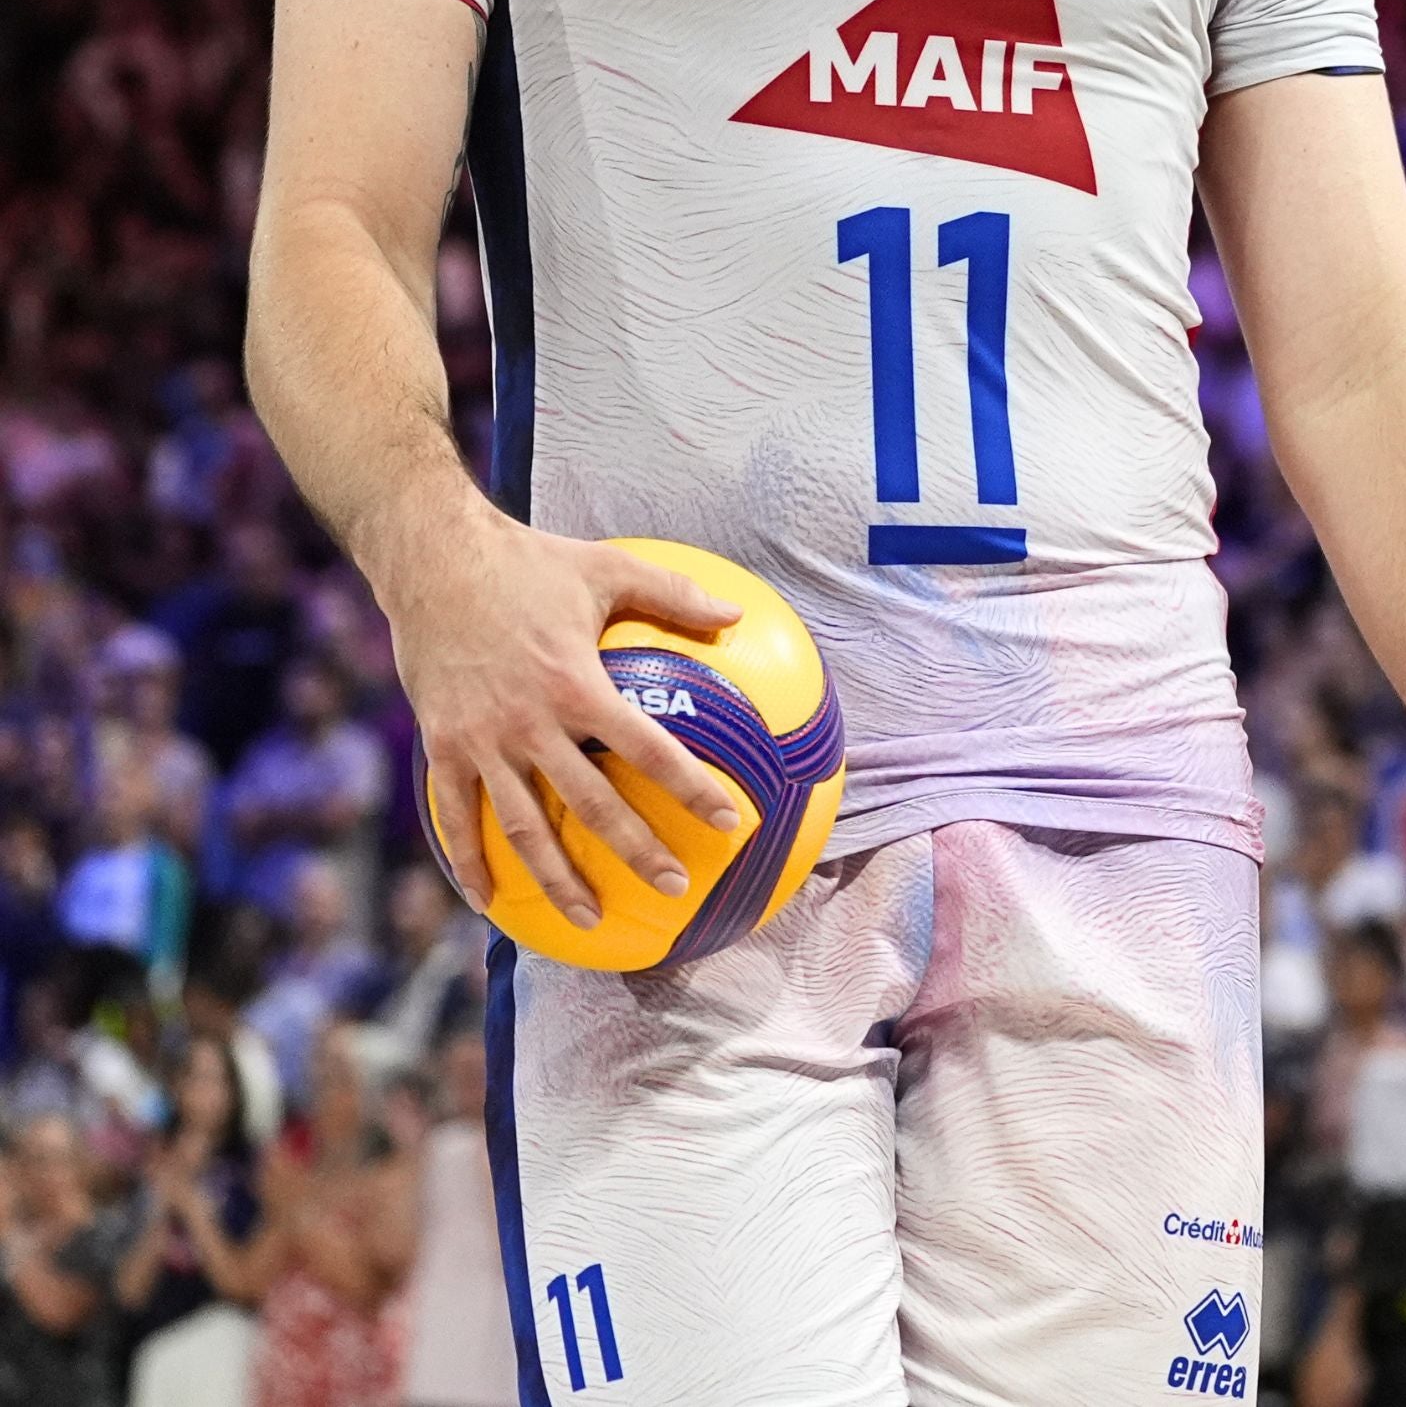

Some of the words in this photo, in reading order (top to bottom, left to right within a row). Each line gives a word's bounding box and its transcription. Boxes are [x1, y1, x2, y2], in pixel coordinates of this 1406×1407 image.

[809, 31, 1066, 114] MAIF
[837, 206, 1017, 505] 11
[621, 688, 697, 716] ASA
[1164, 1213, 1225, 1242] Crédit
[546, 1263, 624, 1393] 11
